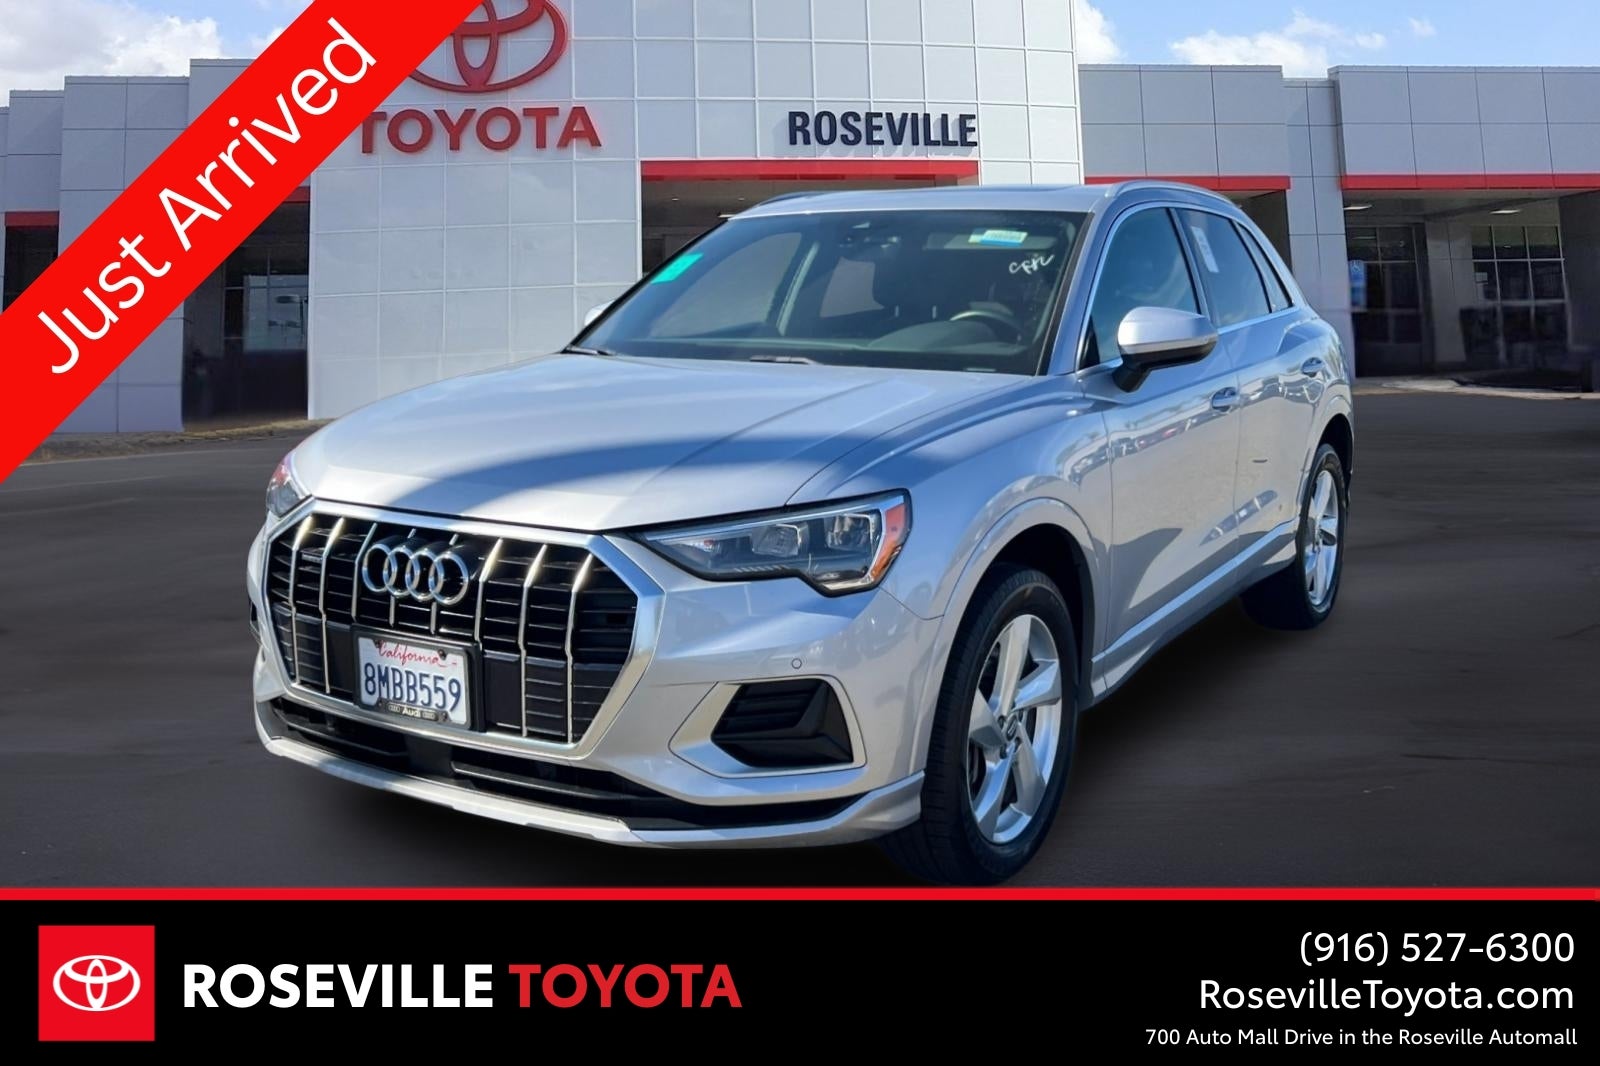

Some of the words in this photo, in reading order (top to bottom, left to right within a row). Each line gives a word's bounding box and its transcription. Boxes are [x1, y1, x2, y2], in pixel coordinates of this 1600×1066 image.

[361, 106, 602, 153] TOYOTA
[789, 110, 978, 147] ROSEVILLE
[379, 641, 444, 667] California
[364, 662, 462, 712] 8MBB559
[402, 705, 421, 718] Audi
